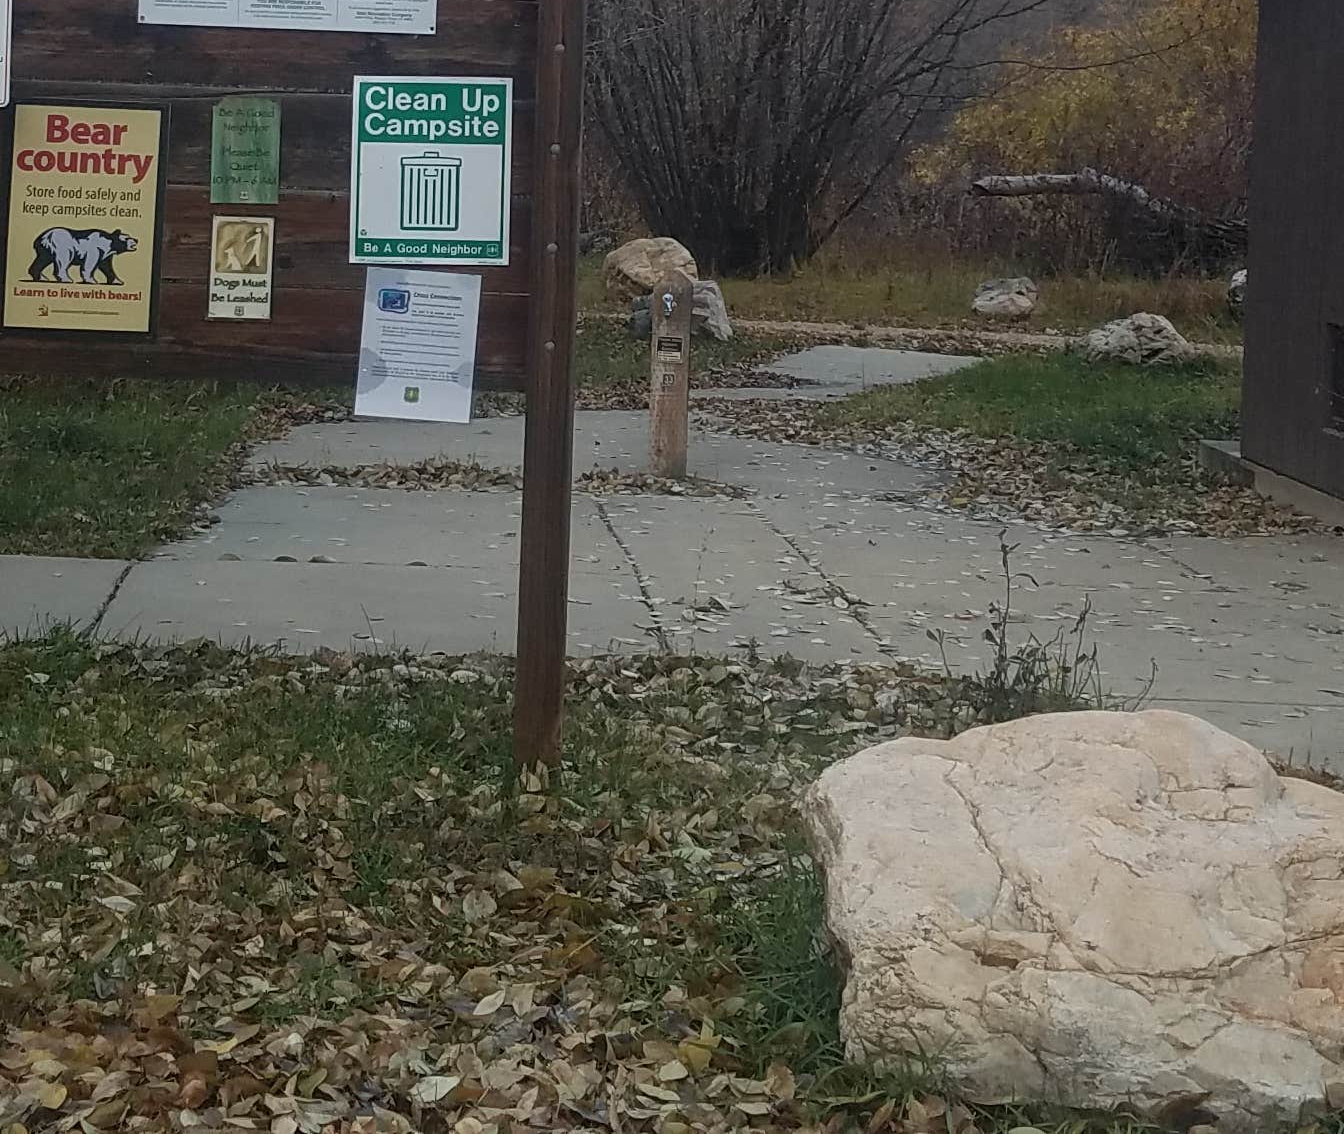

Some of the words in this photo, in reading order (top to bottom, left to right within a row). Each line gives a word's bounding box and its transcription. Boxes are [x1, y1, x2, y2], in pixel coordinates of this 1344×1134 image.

[365, 86, 447, 111] Clean
[462, 88, 500, 117] Up
[46, 114, 128, 146] Bear
[364, 112, 500, 141] Campsite
[16, 148, 154, 184] country
[26, 184, 55, 198] Store
[57, 185, 83, 199] food
[85, 187, 118, 204] safely
[120, 189, 141, 202] and
[22, 201, 49, 217] keep
[52, 203, 107, 218] campsites
[109, 205, 142, 219] clean.
[363, 242, 379, 253] Be
[384, 243, 392, 253] A
[397, 244, 428, 254] Good
[432, 244, 483, 256] Neighbor
[14, 287, 45, 298] Learn
[47, 288, 58, 298] to
[60, 288, 80, 299] live
[82, 289, 106, 300] with
[108, 290, 142, 301] bears!
[214, 278, 240, 291] Dogs
[242, 279, 267, 288] Must
[211, 293, 225, 302] Be
[227, 292, 269, 304] Leashed
